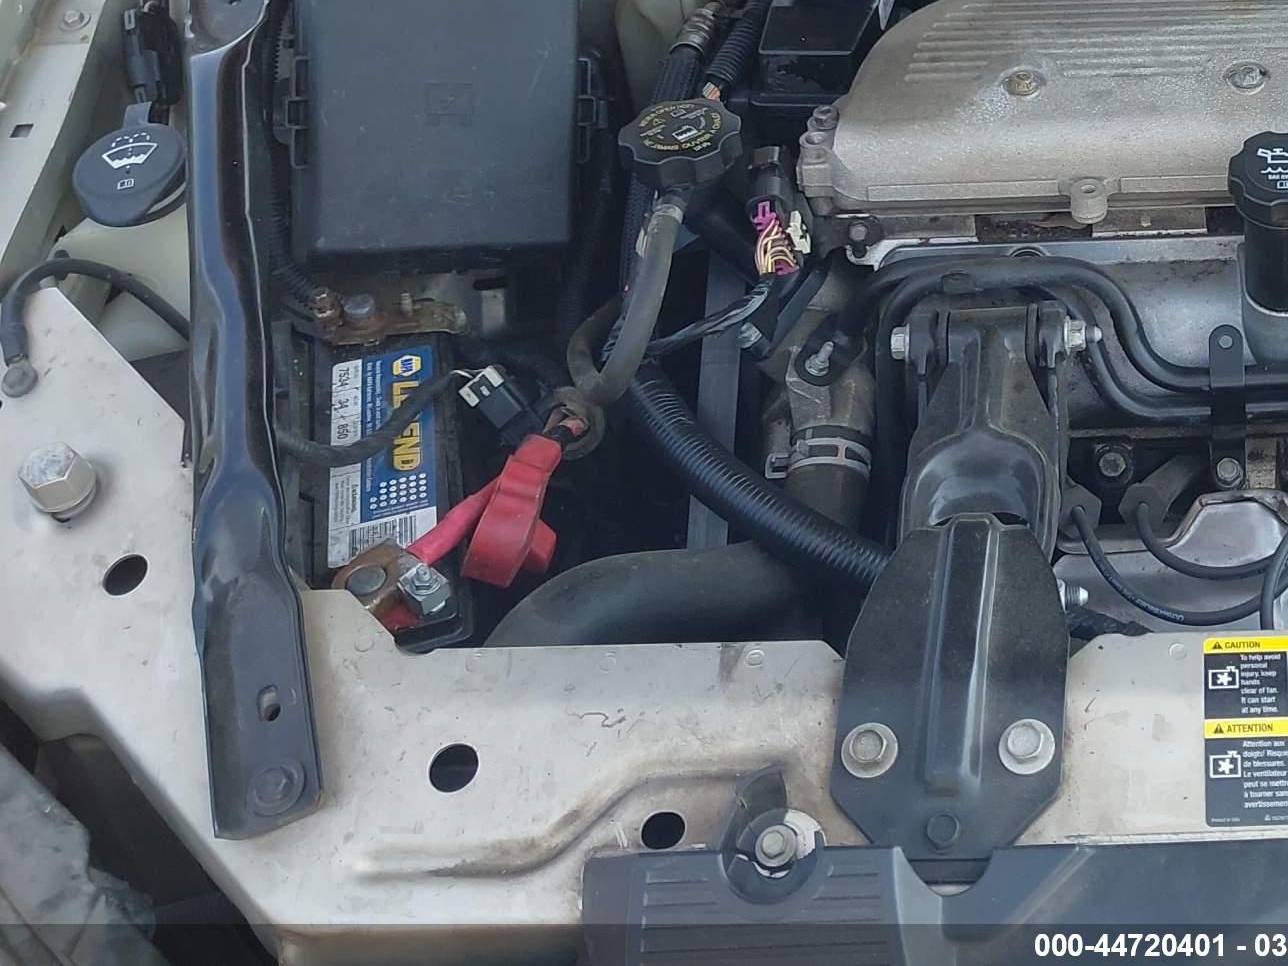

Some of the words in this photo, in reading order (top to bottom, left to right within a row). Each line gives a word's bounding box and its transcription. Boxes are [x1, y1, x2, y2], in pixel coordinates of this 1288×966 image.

[338, 366, 350, 388] 7534
[337, 423, 349, 440] 850
[392, 380, 423, 470] LEND
[1226, 723, 1273, 732] ATTENTION
